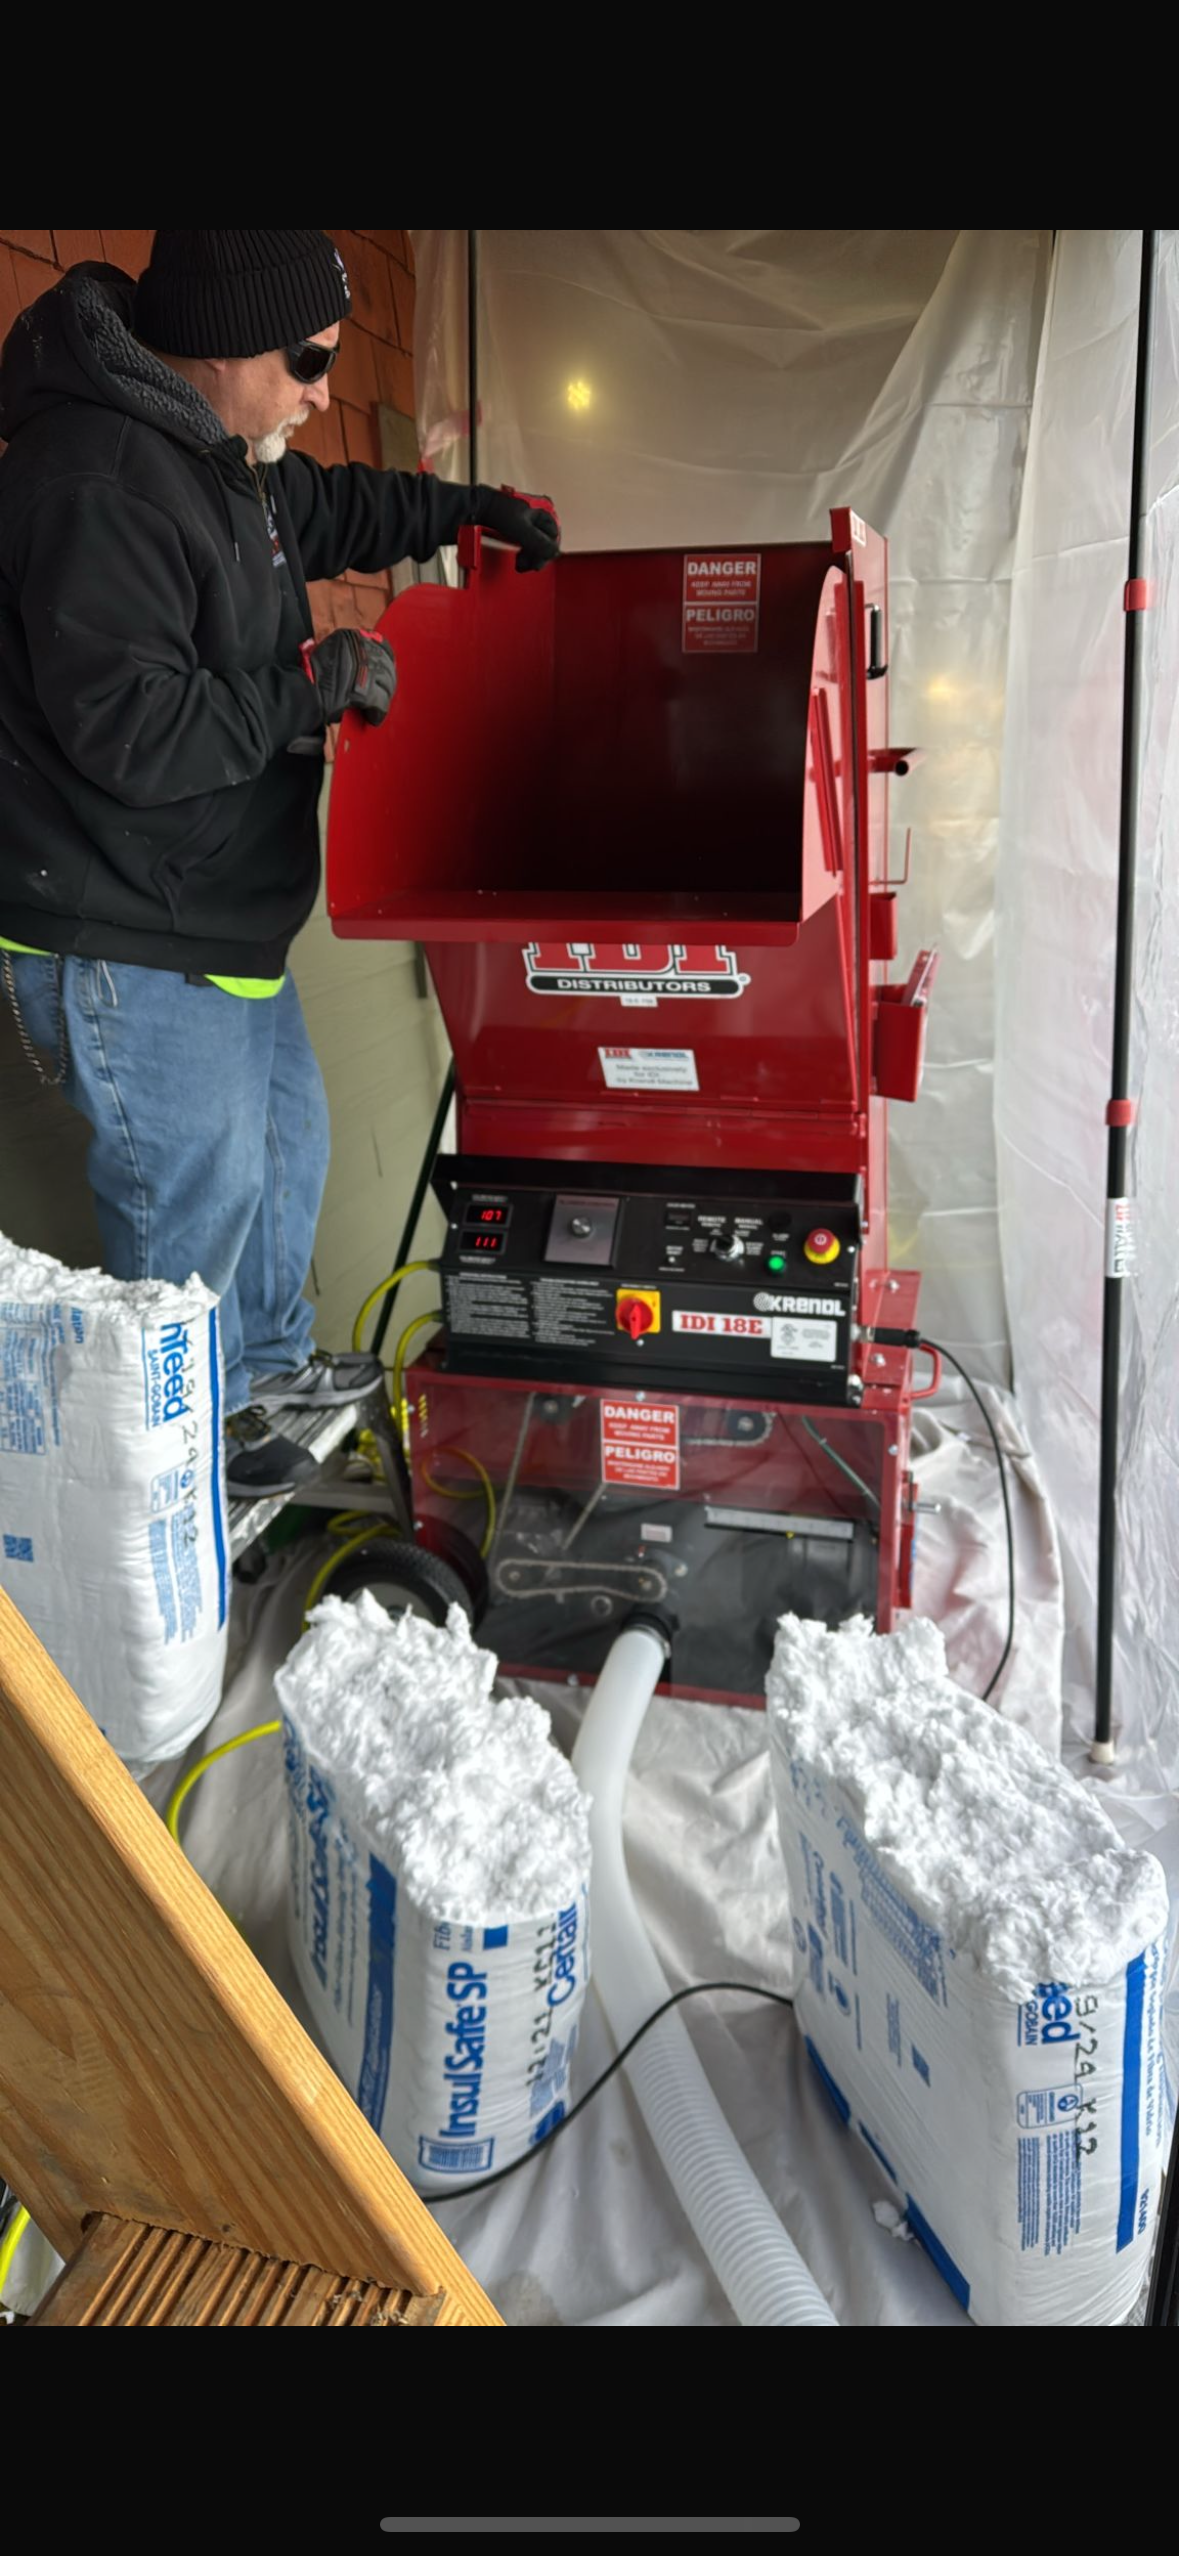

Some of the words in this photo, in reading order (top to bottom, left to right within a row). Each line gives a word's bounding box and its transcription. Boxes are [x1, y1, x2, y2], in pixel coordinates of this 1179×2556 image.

[687, 561, 757, 576] DANGER
[686, 608, 755, 622] PELIGRO
[557, 978, 711, 993] DISTRIBUTORS
[680, 1313, 717, 1332] IDI
[722, 1317, 764, 1336] 18E
[147, 1349, 162, 1428] SAINT-GOBAIN
[604, 1405, 676, 1424] DANGER
[605, 1445, 676, 1464] PELIGRO
[445, 1961, 488, 2002] SP
[438, 2003, 485, 2139] InsulSafe
